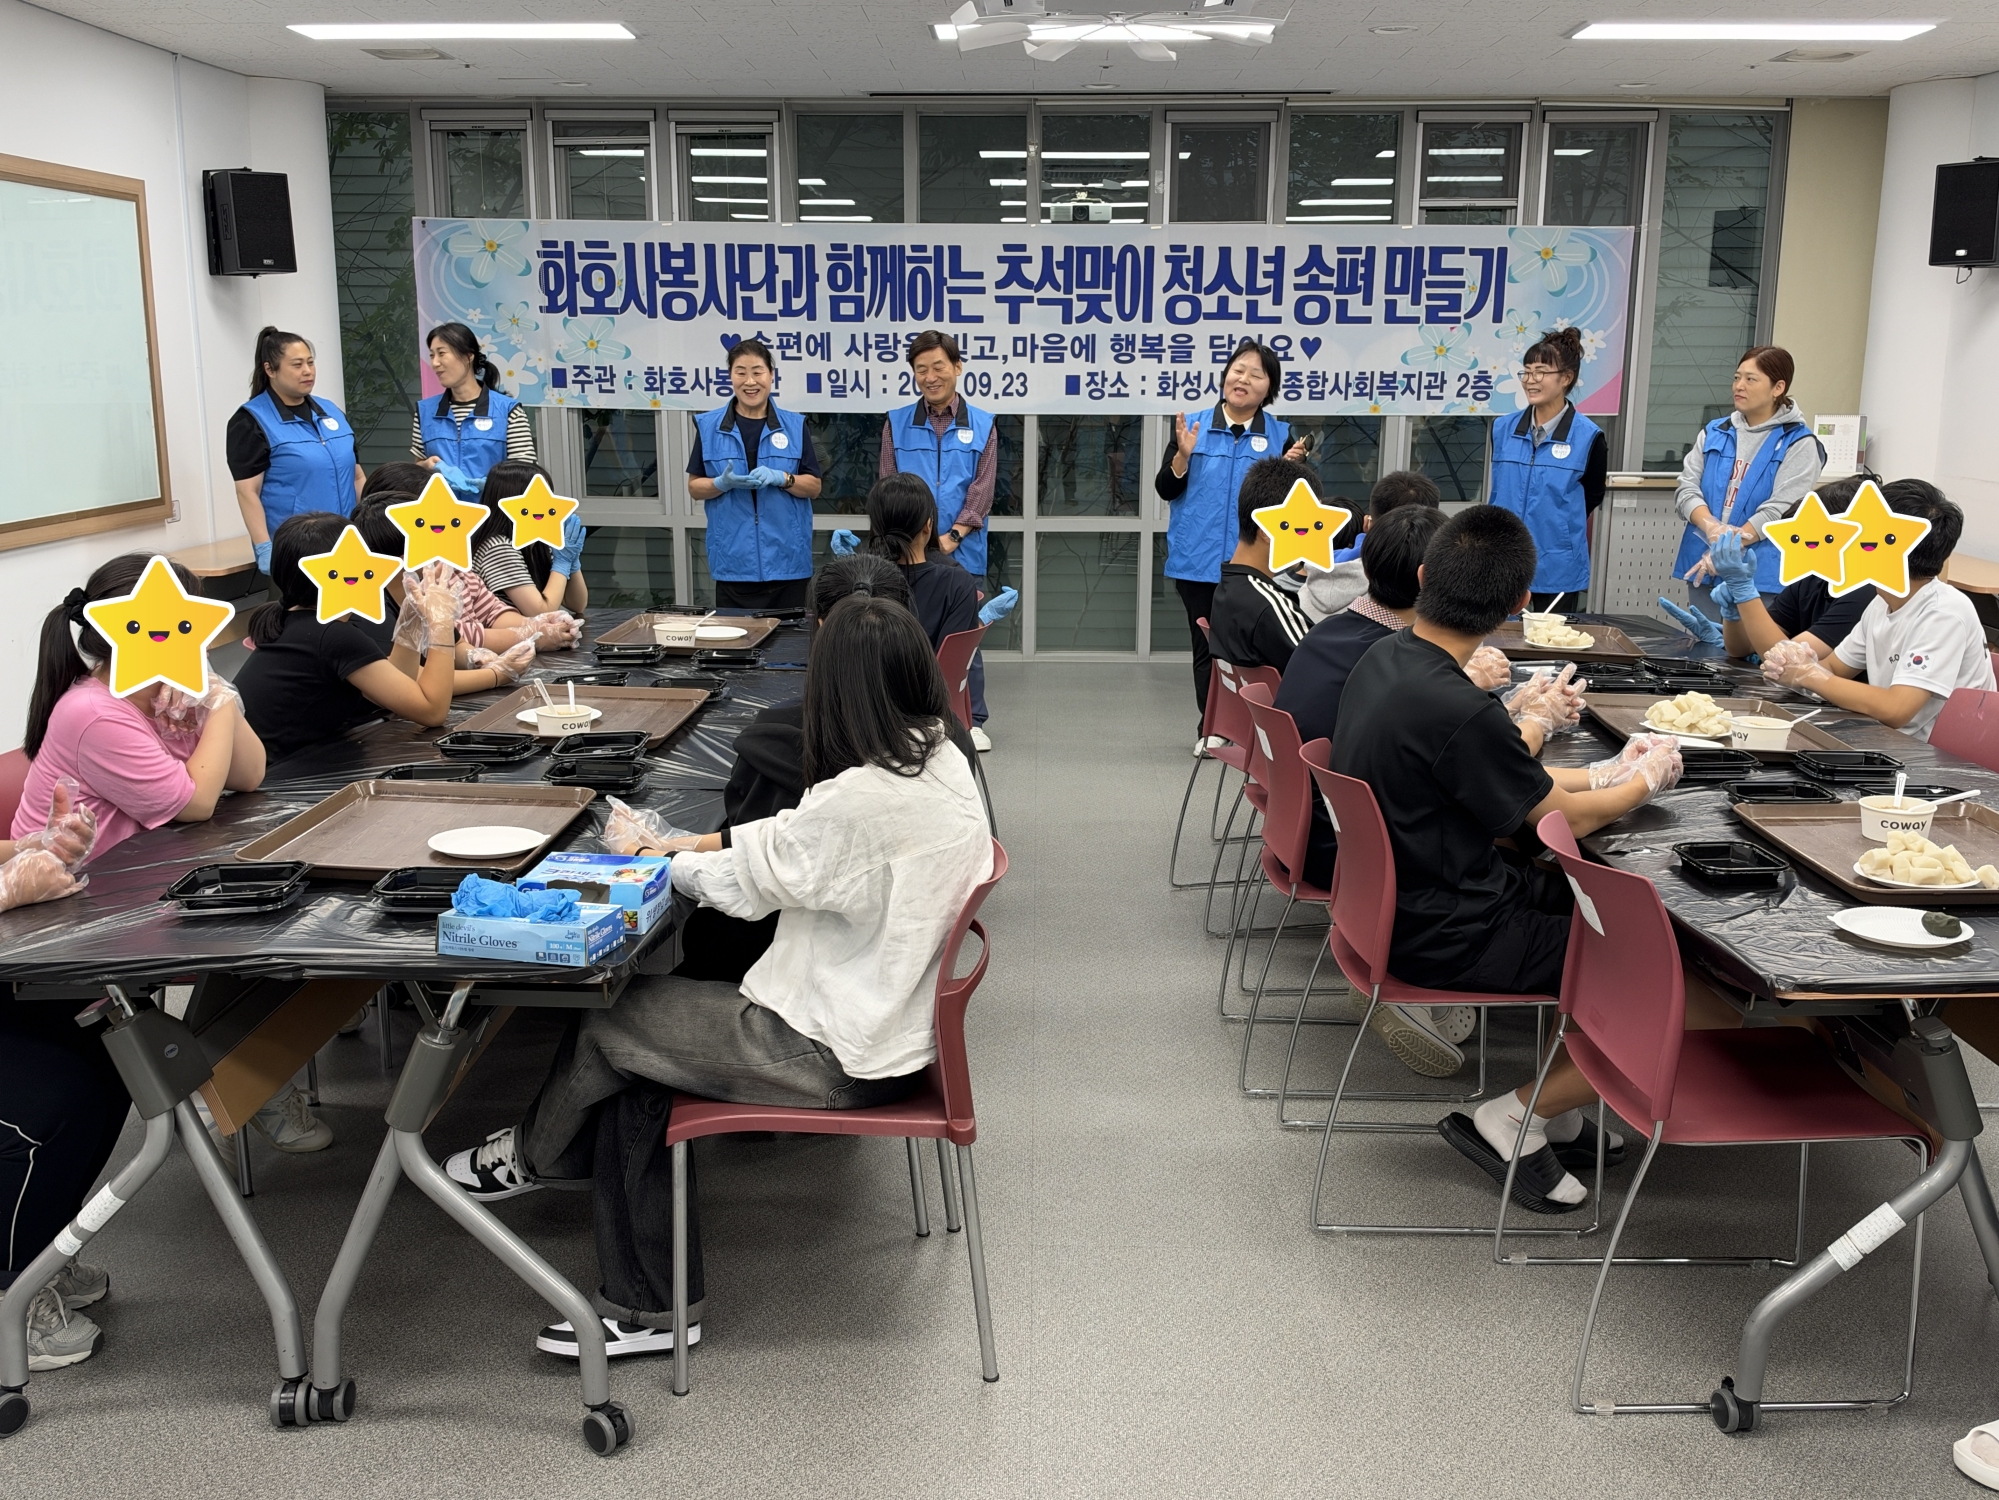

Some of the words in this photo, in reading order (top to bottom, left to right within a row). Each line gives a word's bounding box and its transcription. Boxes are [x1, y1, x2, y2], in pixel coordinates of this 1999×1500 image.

[536, 239, 820, 322] 화호사봉사단과
[825, 242, 987, 324] 함께하는
[994, 243, 1155, 325] 추석맞이
[1162, 244, 1286, 326] 청소년
[1292, 244, 1377, 326] 송편
[1383, 245, 1508, 325] 만들기
[1110, 333, 1196, 365] 행복을
[571, 364, 616, 394] 주관
[827, 368, 870, 399] 일시
[1085, 370, 1130, 401] 장소
[1455, 370, 1494, 402] 2층
[1880, 820, 1928, 832] coway
[441, 930, 477, 945] Nitrile
[478, 934, 518, 949] Gloves
